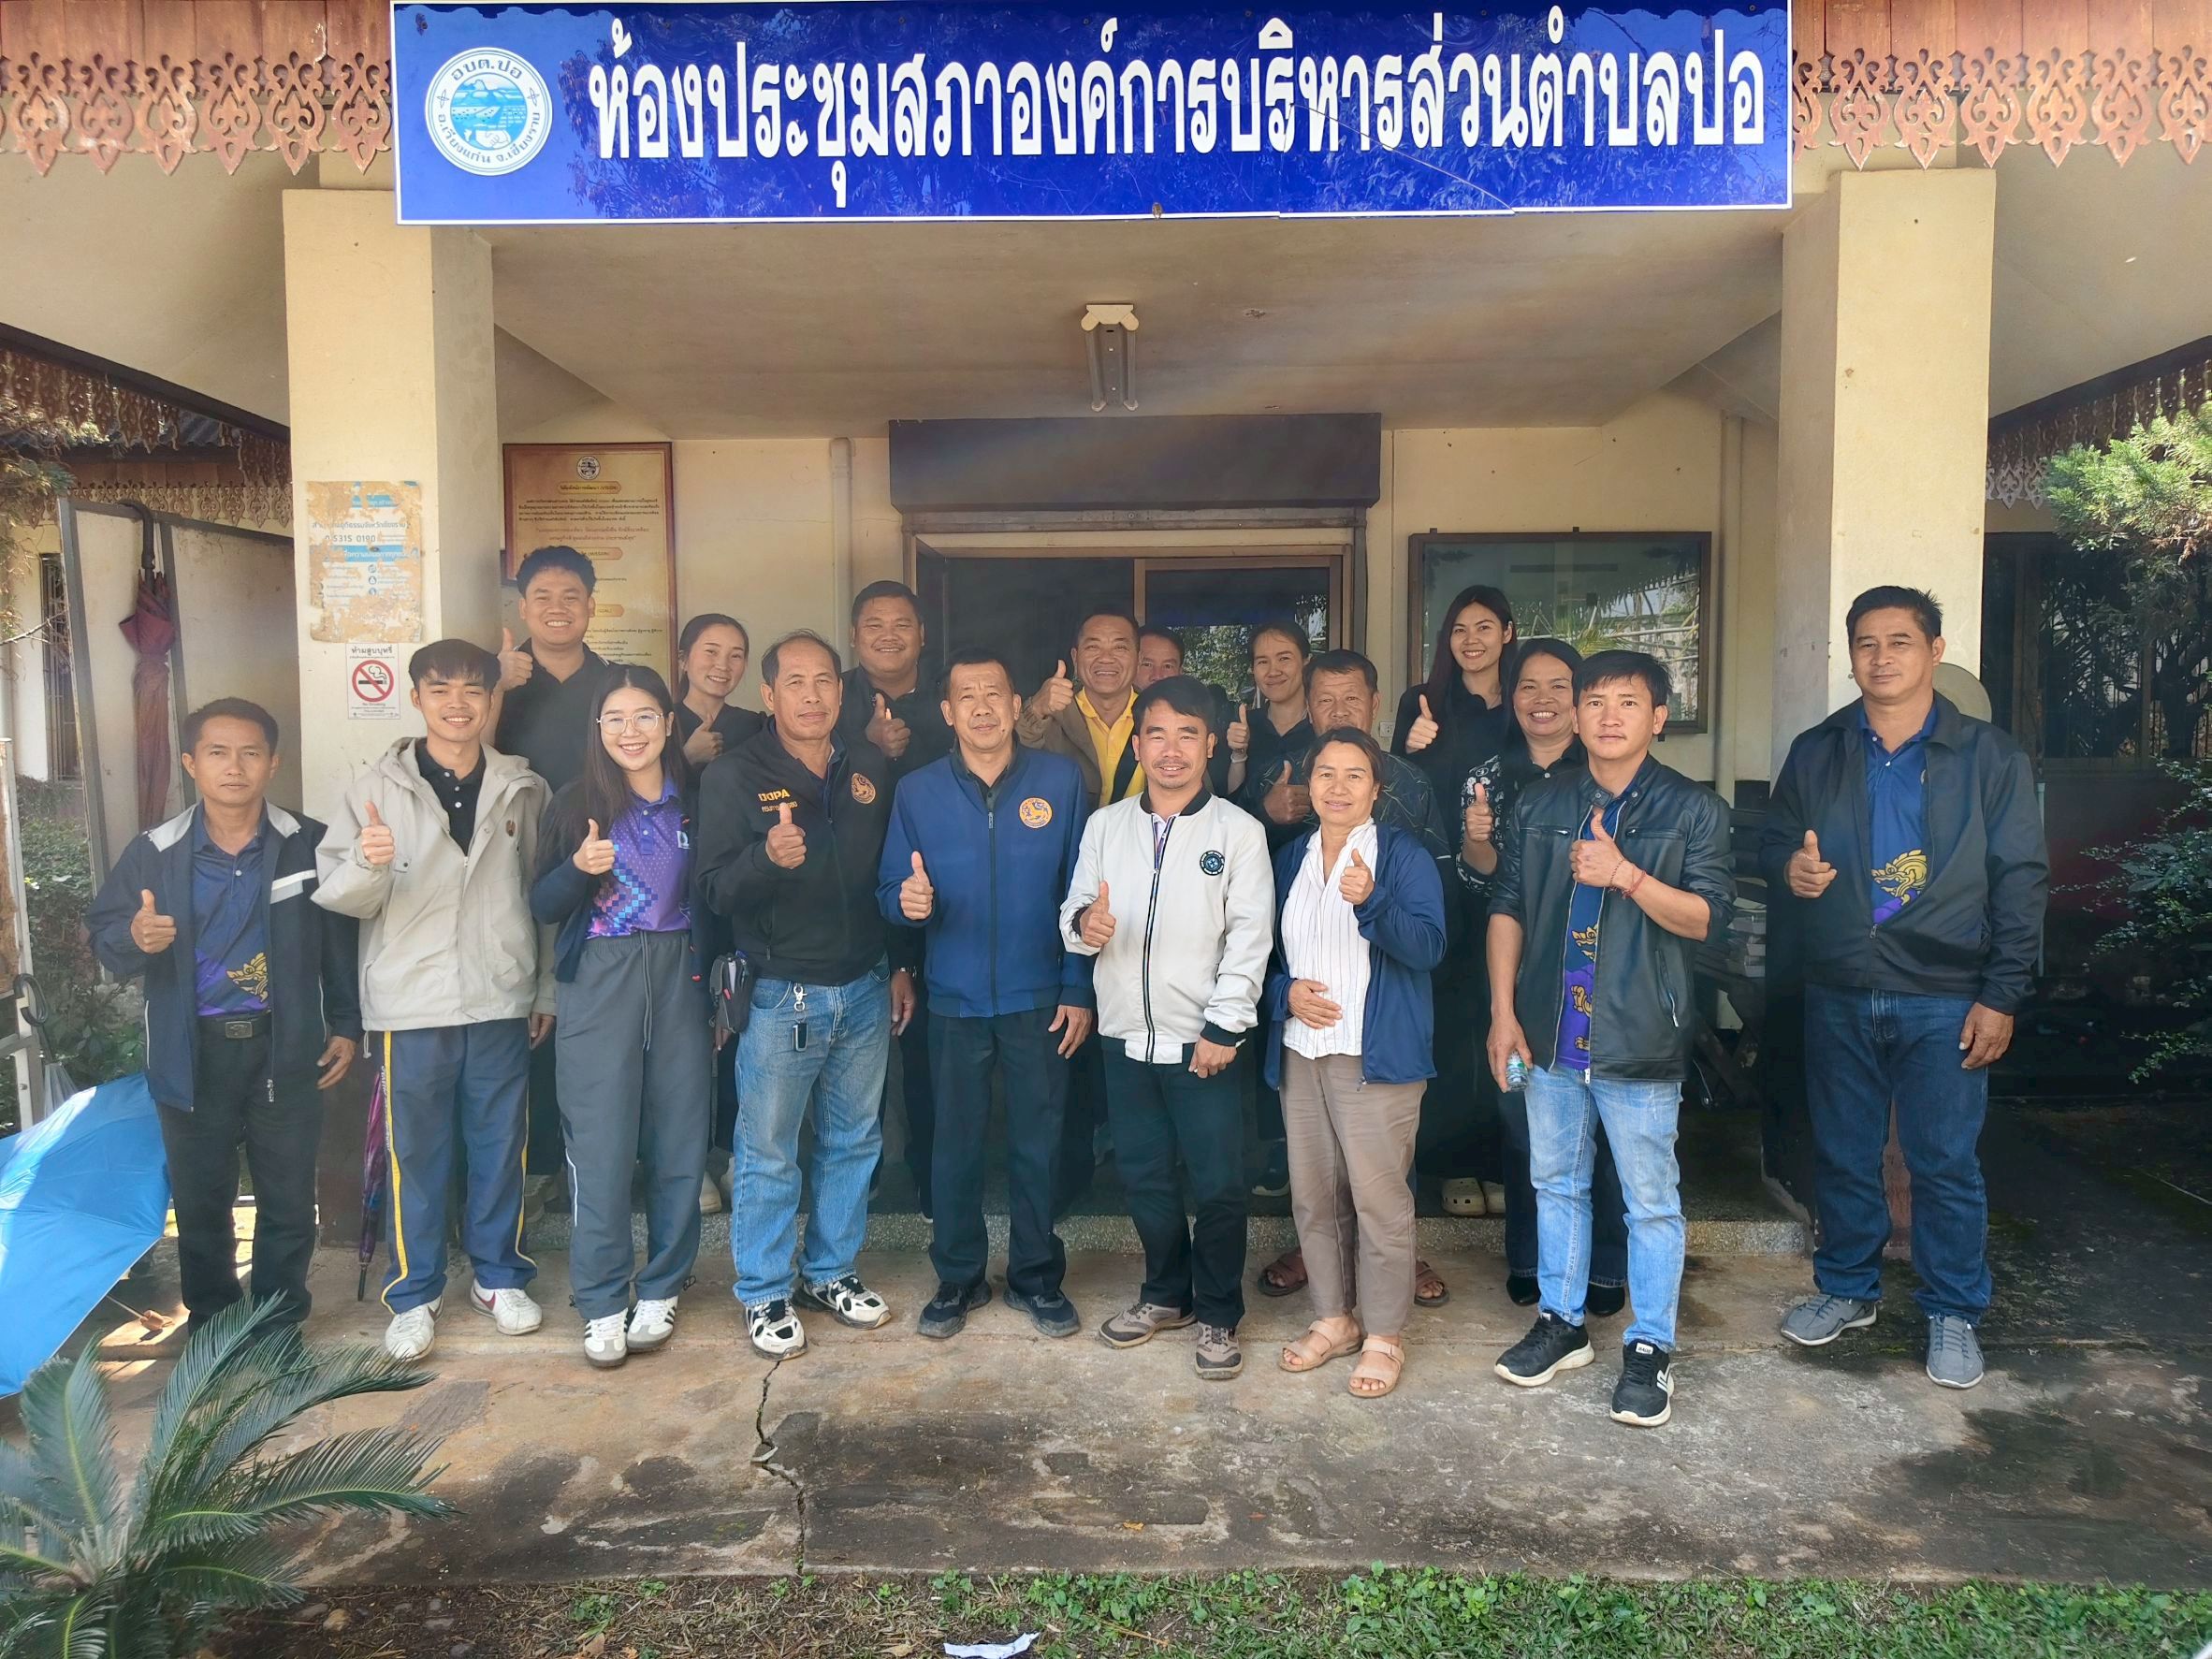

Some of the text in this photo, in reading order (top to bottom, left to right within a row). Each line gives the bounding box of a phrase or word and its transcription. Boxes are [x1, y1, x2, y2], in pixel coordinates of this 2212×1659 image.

[450, 58, 523, 81] อบต.ปอ
[589, 5, 1765, 209] ห้องประชุมสภาองค์การบริหารส่วนตำบลปอ
[437, 111, 541, 164] อ.เวียงแก่น จ.เชียงราย
[333, 534, 353, 543] 5315
[356, 534, 376, 543] 0190
[351, 645, 393, 656] ห้ามสูบบุหรี่
[758, 788, 791, 802] DOPA
